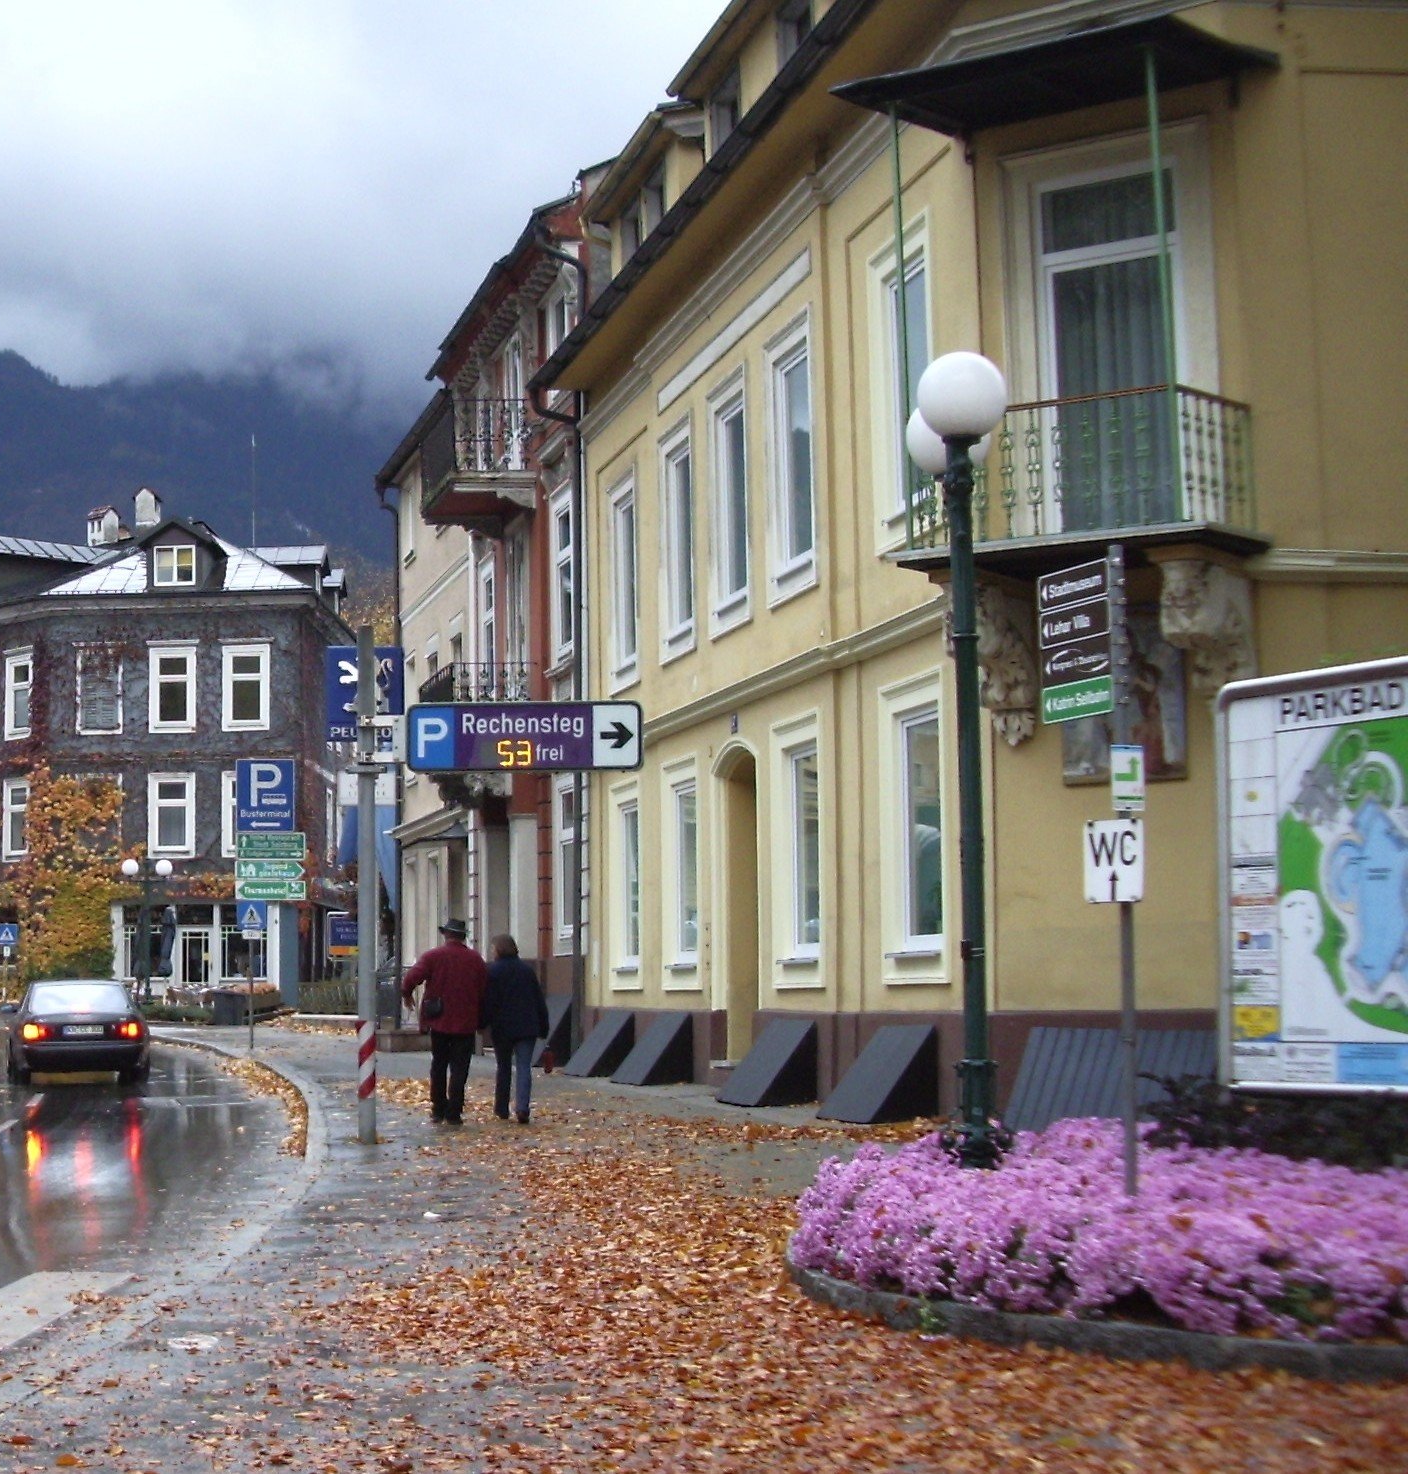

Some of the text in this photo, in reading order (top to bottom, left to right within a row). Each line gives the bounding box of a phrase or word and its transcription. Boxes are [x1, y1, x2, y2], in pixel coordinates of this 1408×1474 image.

[1280, 681, 1405, 725] PARKBAD
[330, 726, 392, 738] PEUEO
[417, 717, 448, 758] P
[461, 712, 584, 738] Rechensteg
[497, 740, 564, 767] 53 frei
[250, 763, 282, 807] P
[240, 809, 291, 818] Busterminal
[1088, 830, 1137, 867] WC
